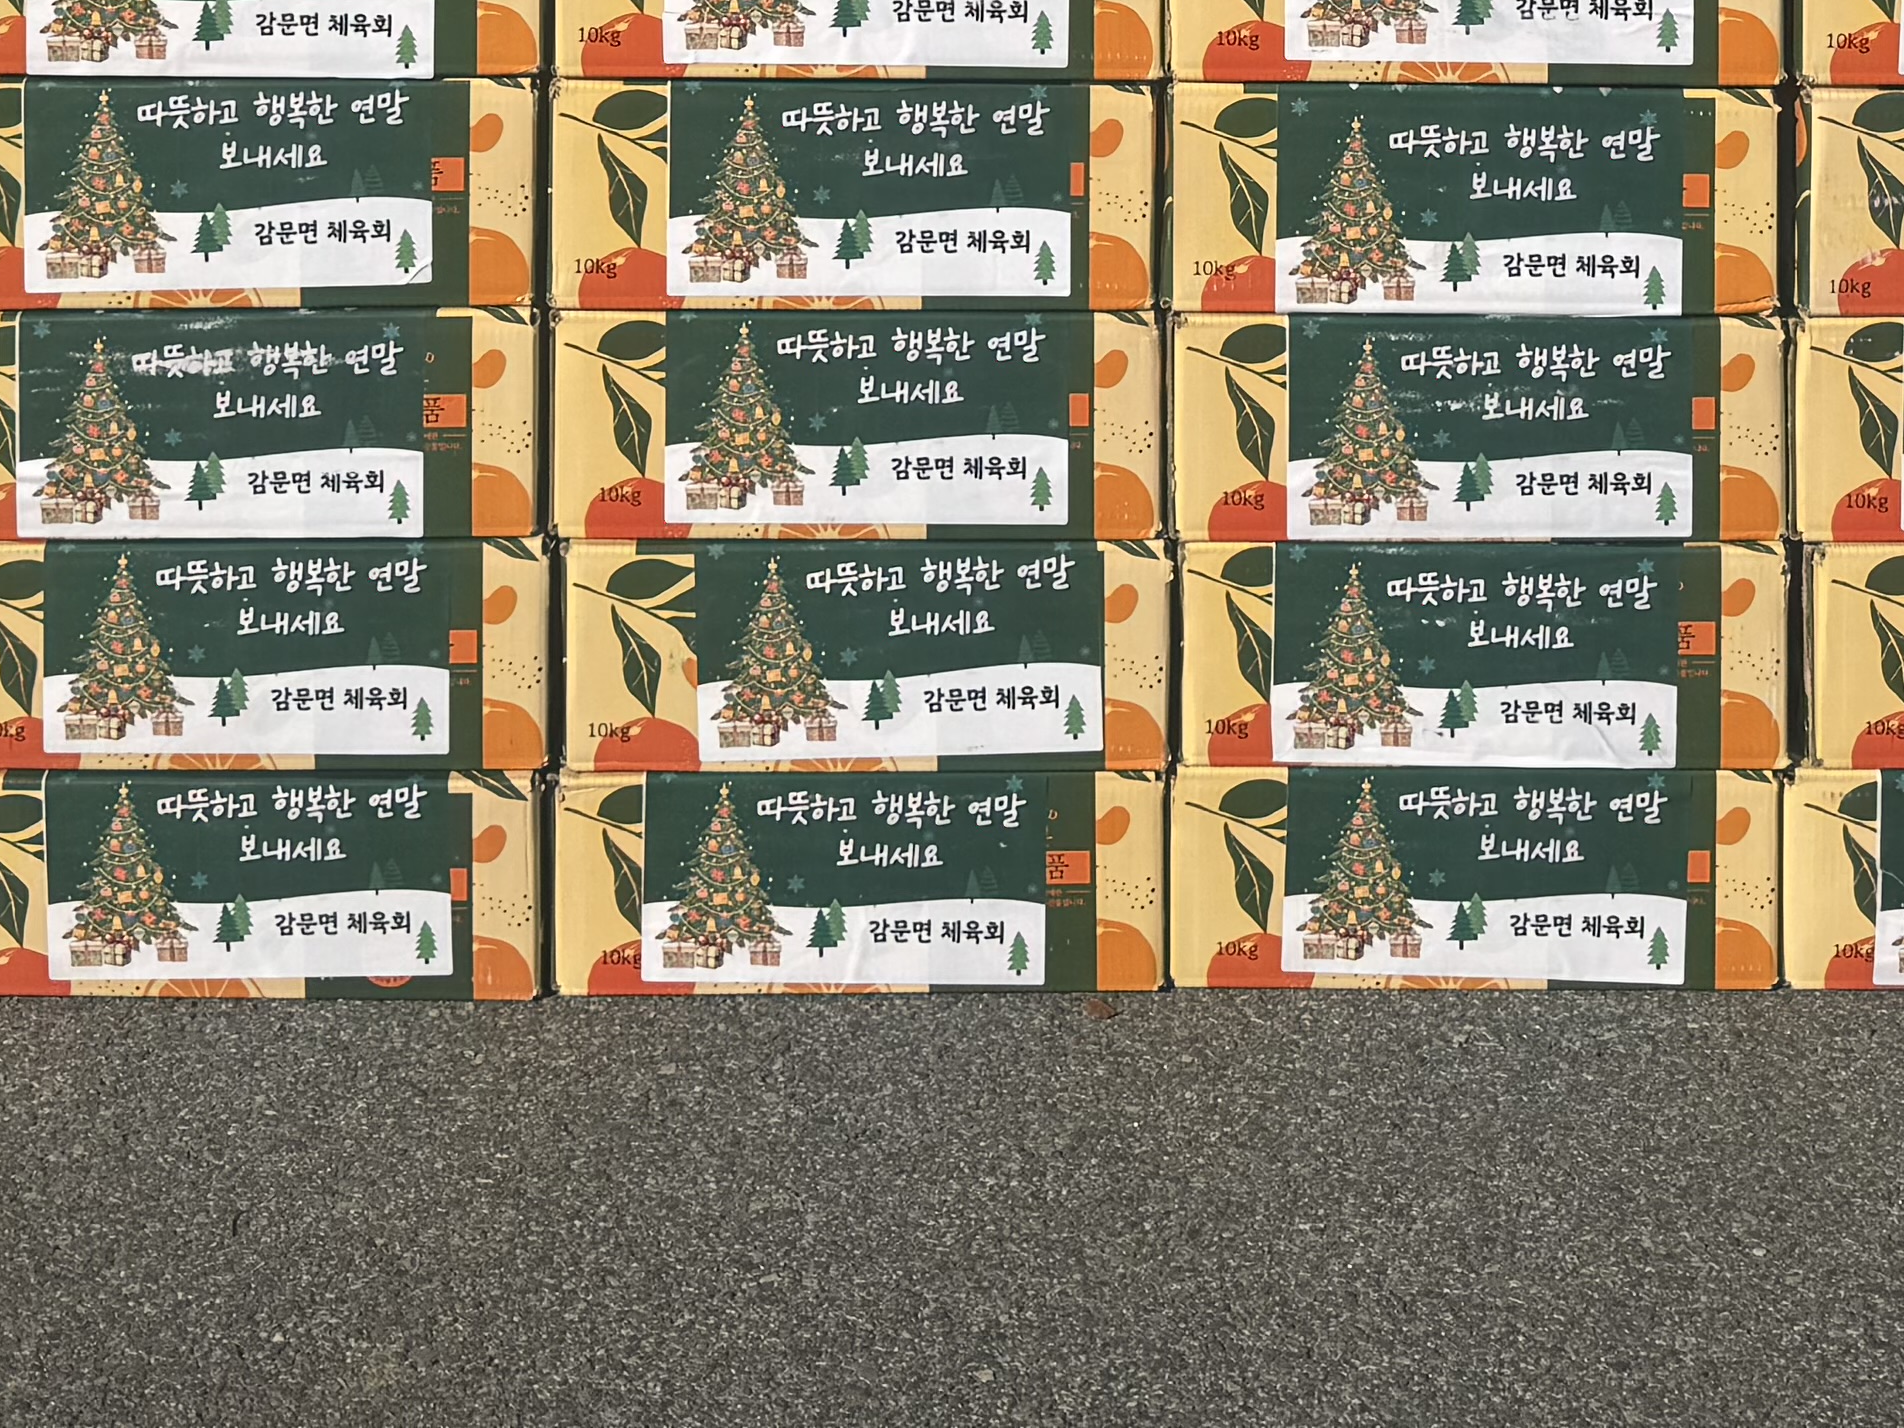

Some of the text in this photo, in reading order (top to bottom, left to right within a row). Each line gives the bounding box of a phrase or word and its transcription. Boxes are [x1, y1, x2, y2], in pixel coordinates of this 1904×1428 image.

[578, 25, 621, 48] 10kg
[1827, 32, 1870, 54] 10kg
[775, 326, 1046, 366] 따뜻하고 행복한 연말
[856, 375, 966, 406] 보내세요
[890, 455, 1027, 482] 감문면 체육회
[589, 722, 631, 743] 10kg
[1206, 717, 1249, 739] 10kg
[155, 783, 428, 824] 따뜻하고 행복한 연말
[1397, 785, 1669, 826] 따뜻하고 행복한 연말
[237, 833, 348, 863] 보내세요
[1476, 832, 1586, 864] 보내세요
[274, 909, 412, 937] 감문면 체육회
[1509, 911, 1645, 940] 감문면 체육회
